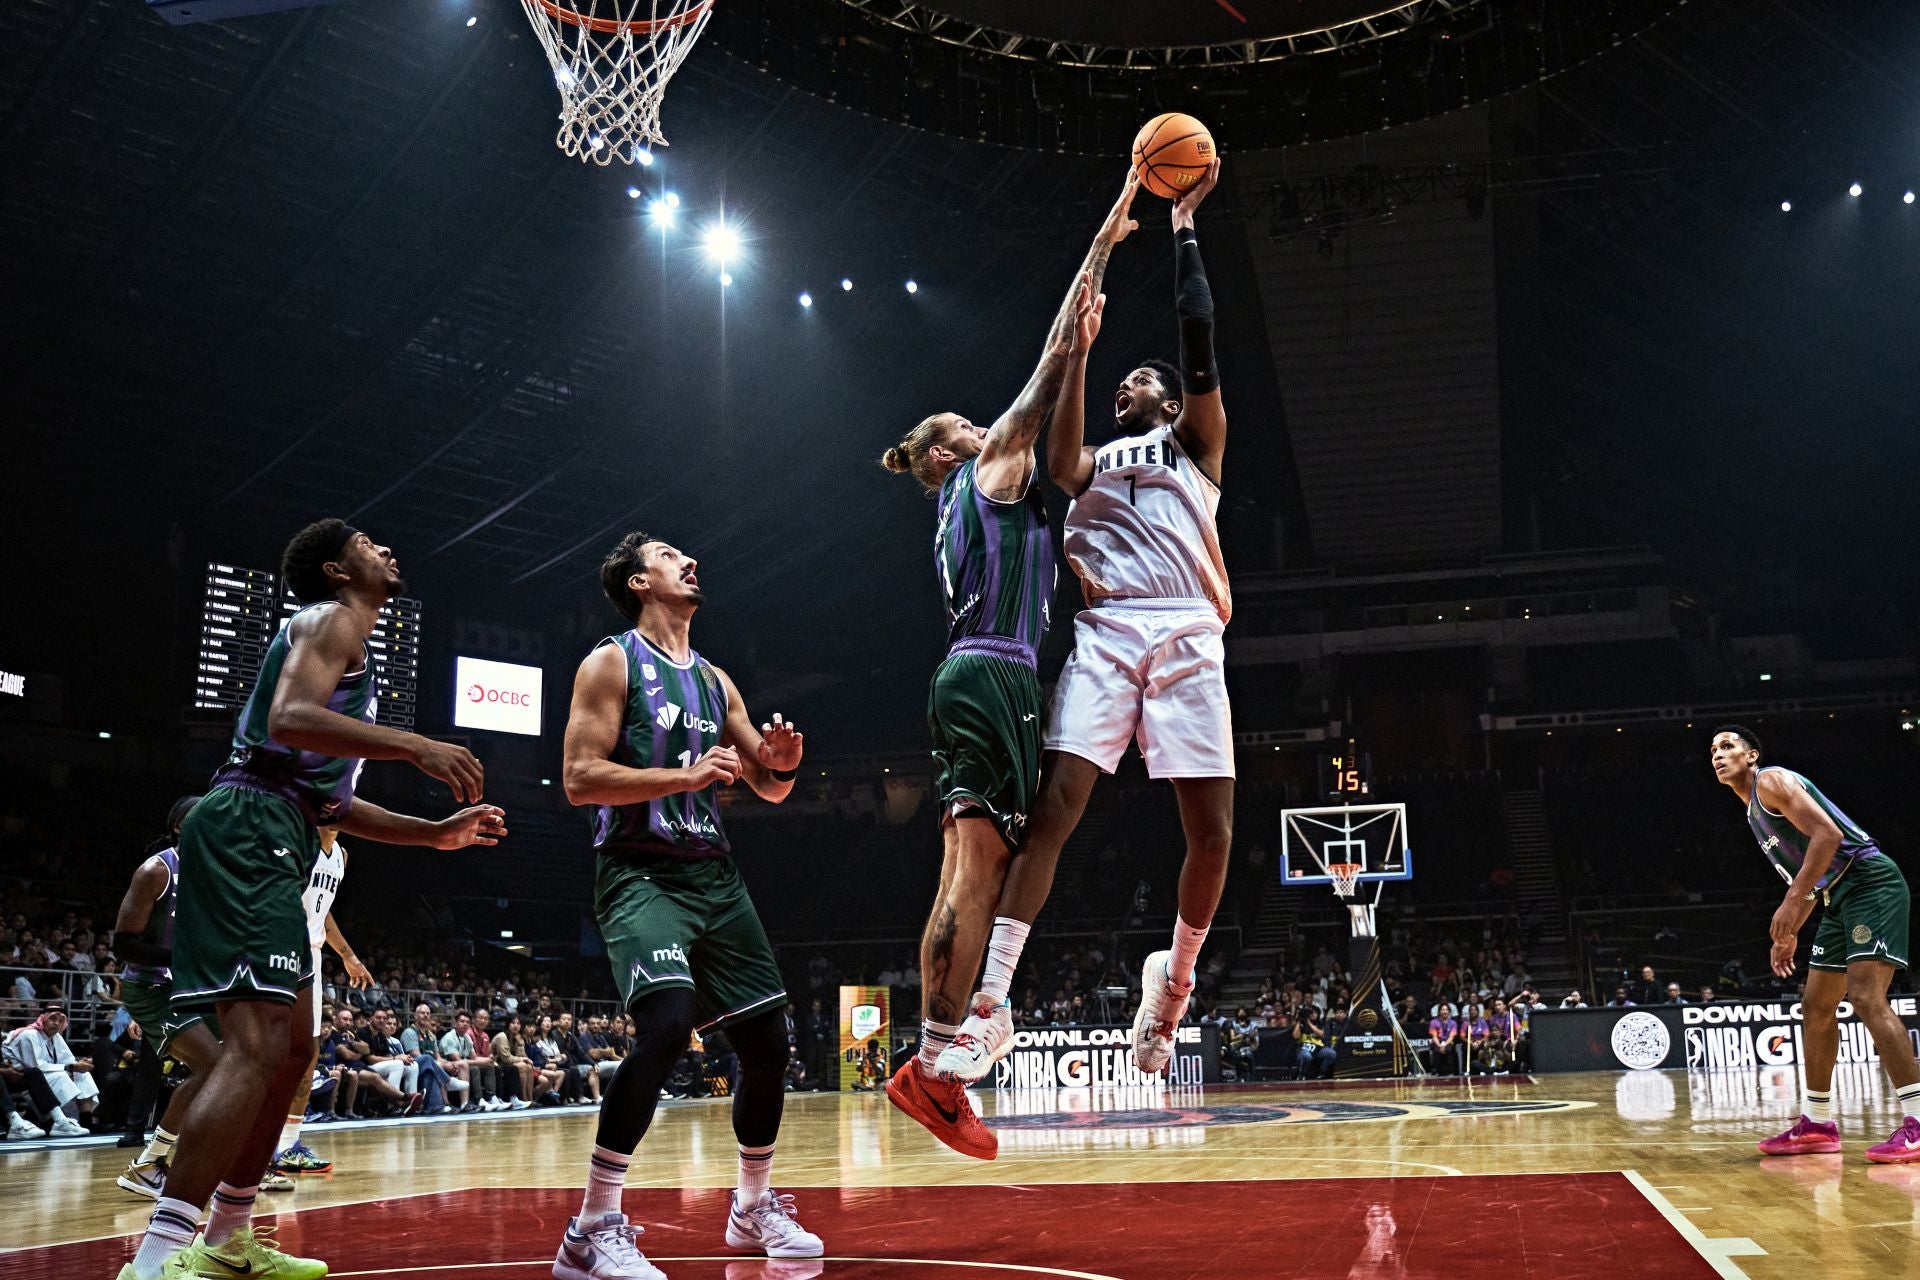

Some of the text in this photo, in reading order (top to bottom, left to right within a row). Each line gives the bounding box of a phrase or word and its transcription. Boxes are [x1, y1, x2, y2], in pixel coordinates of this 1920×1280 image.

[1098, 440, 1177, 472] NITED
[1124, 474, 1136, 506] 7
[487, 689, 531, 707] OCBC
[1332, 757, 1342, 769] 4
[1338, 770, 1359, 791] 15
[311, 872, 341, 894] NITE
[315, 893, 324, 914] 6
[1682, 1001, 1854, 1025] DOWNLOD
[1014, 1028, 1134, 1048] OWNLOA
[1705, 1026, 1757, 1069] NBA
[1756, 1025, 1794, 1066] G
[1794, 1022, 1880, 1064] LGUE
[1014, 1050, 1057, 1088] NBA
[1057, 1049, 1090, 1088] G
